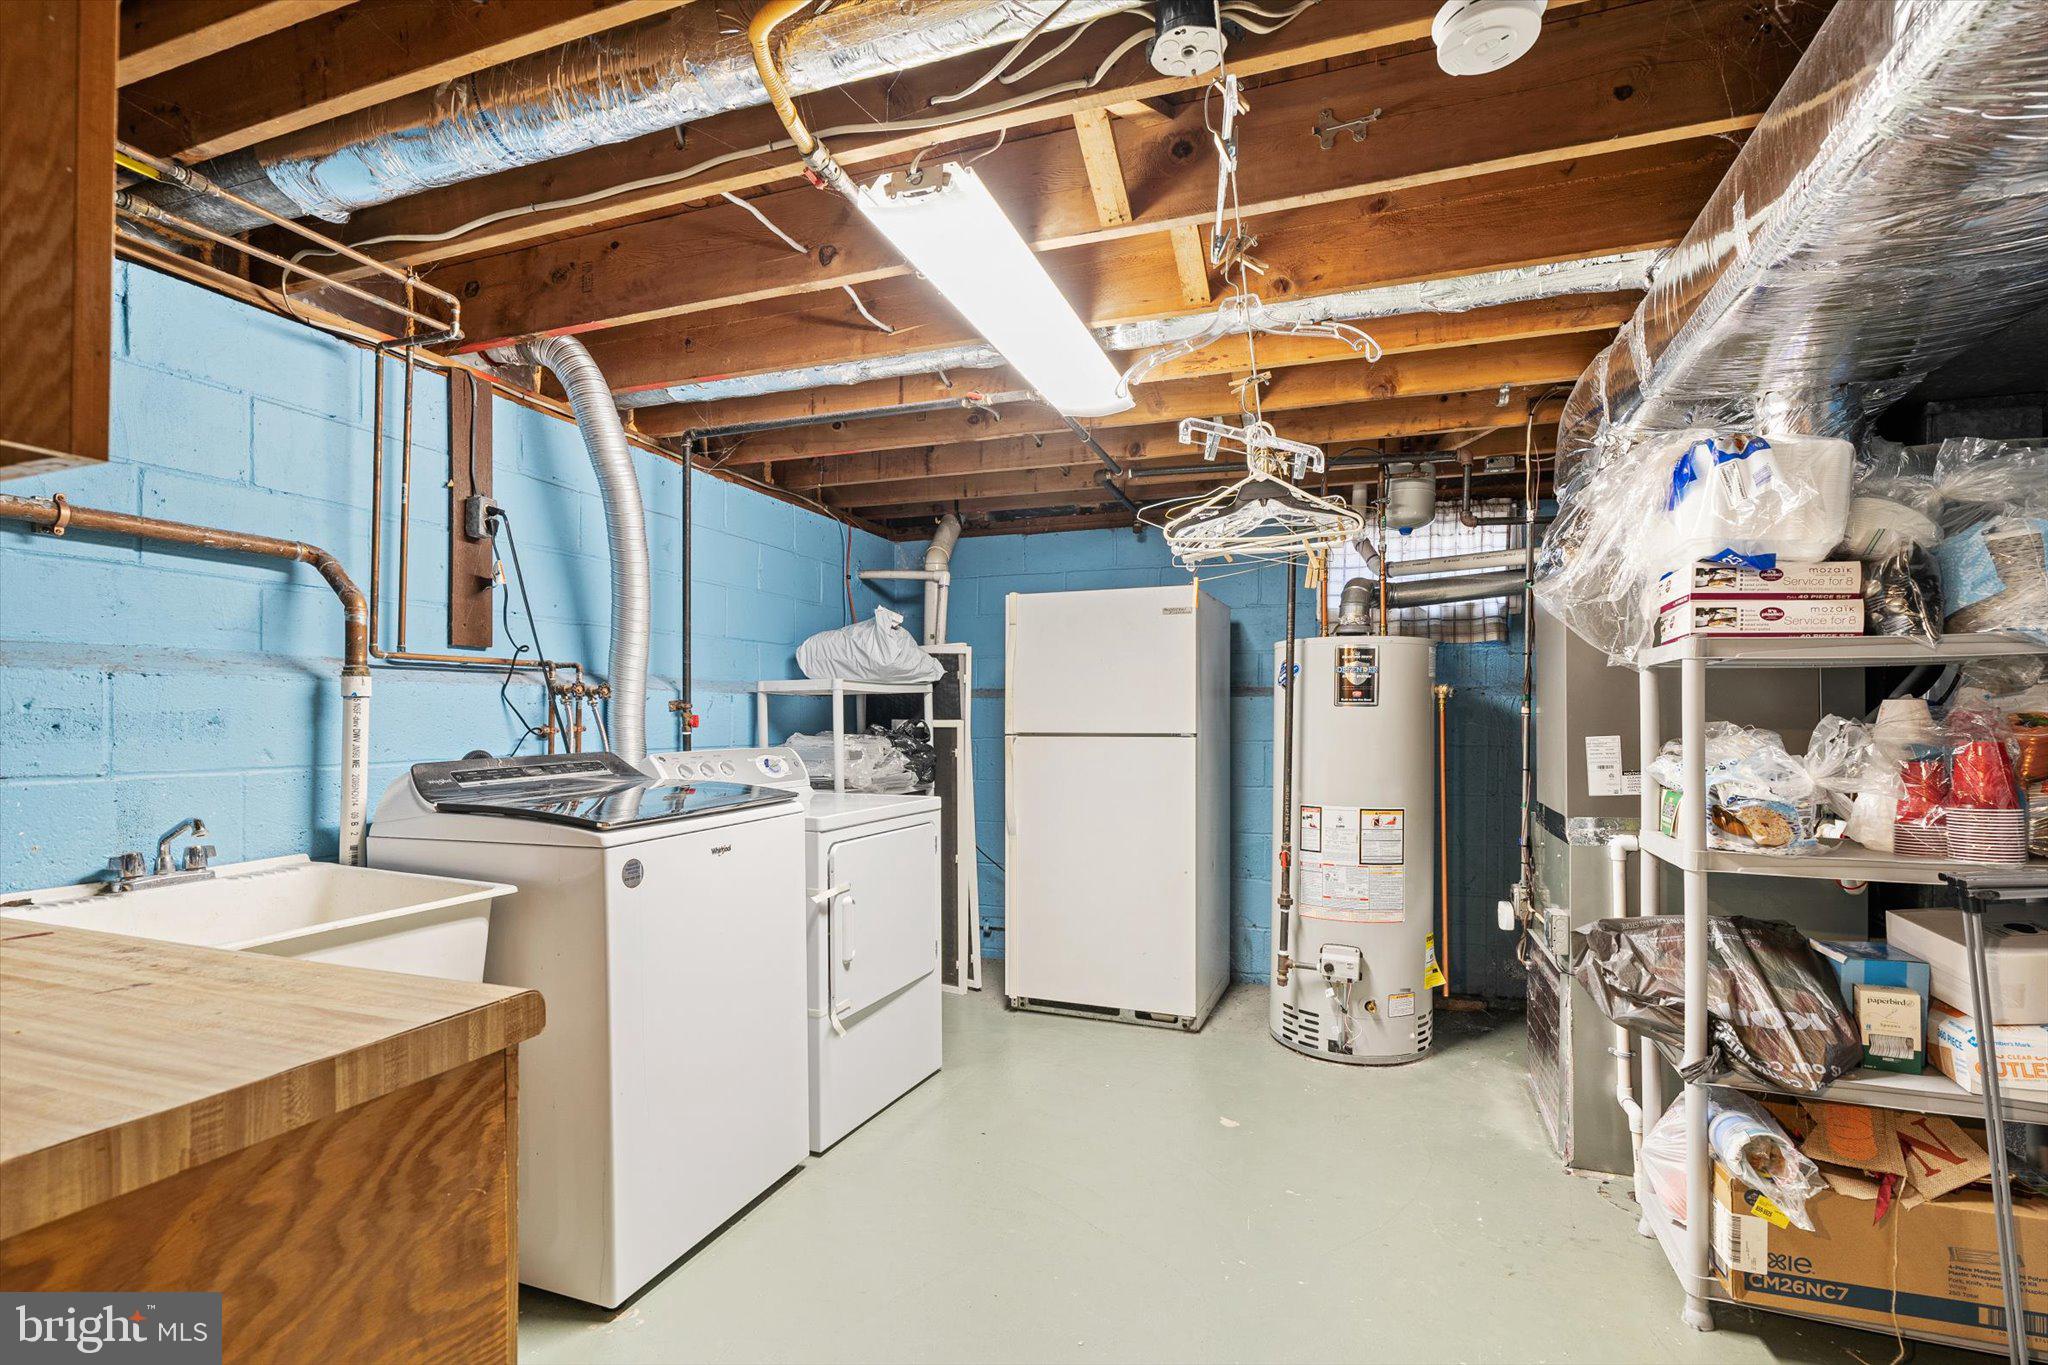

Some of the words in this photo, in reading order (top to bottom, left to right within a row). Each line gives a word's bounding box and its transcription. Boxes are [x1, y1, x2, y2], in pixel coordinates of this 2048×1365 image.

[1783, 576, 1826, 586] Service
[1829, 576, 1844, 586] for
[1846, 576, 1854, 586] 8
[1784, 615, 1827, 626] Service
[1831, 615, 1846, 625] for
[1848, 615, 1857, 626] 8
[711, 845, 732, 856] Whirlpool
[1867, 997, 1906, 1006] paperbird
[1896, 1116, 1969, 1178] N
[1748, 1273, 1850, 1301] CM26NC7
